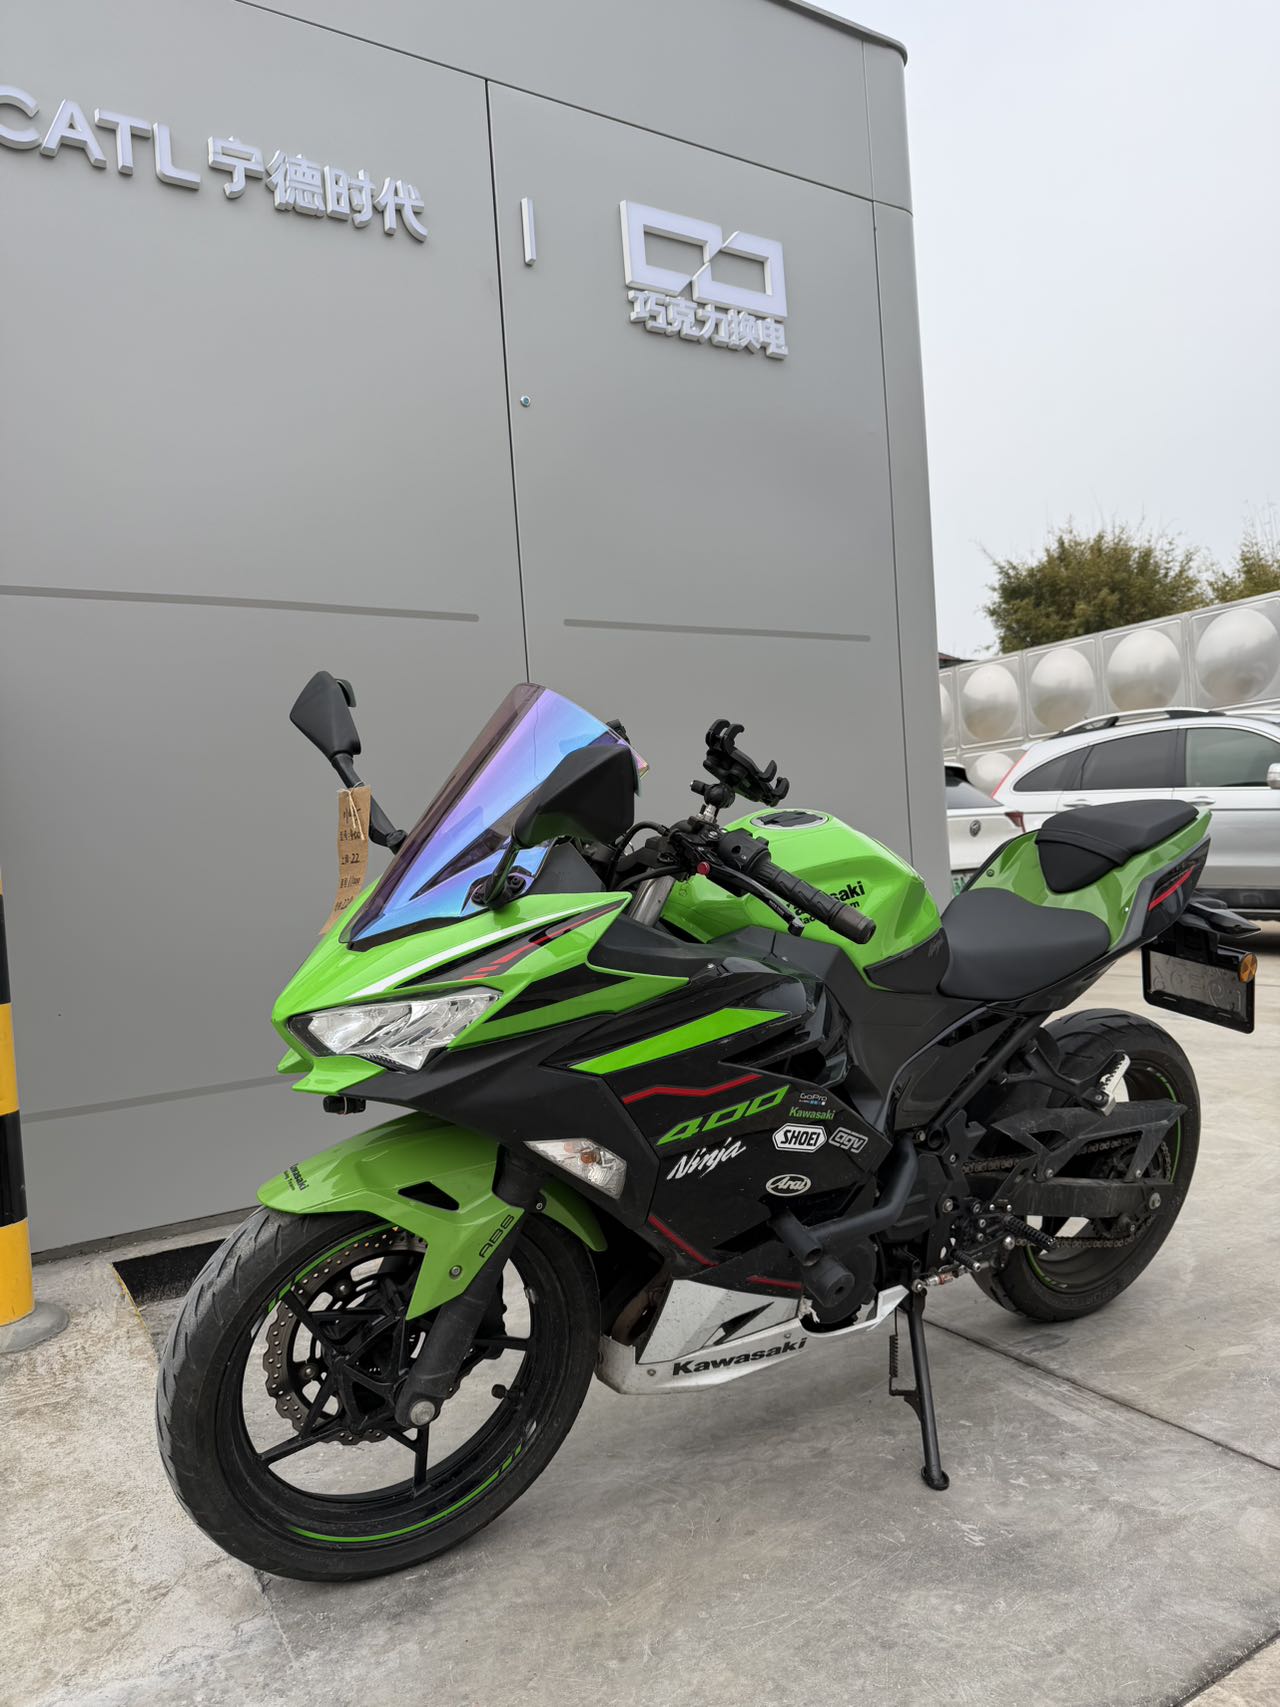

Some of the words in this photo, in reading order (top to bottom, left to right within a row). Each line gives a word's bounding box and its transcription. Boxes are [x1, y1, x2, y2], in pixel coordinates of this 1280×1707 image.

[0, 85, 200, 190] CATL
[206, 135, 429, 242] 宁德时代
[627, 290, 789, 360] 巧克力换电
[656, 1085, 790, 1145] 400
[789, 1106, 836, 1120] Kawasaki
[799, 1092, 828, 1101] GoPro
[666, 1137, 747, 1180] Ninja
[780, 1129, 821, 1147] SHOEI
[773, 1175, 808, 1190] Arai
[479, 1214, 515, 1258] ABS
[672, 1337, 808, 1376] Kawasaki
